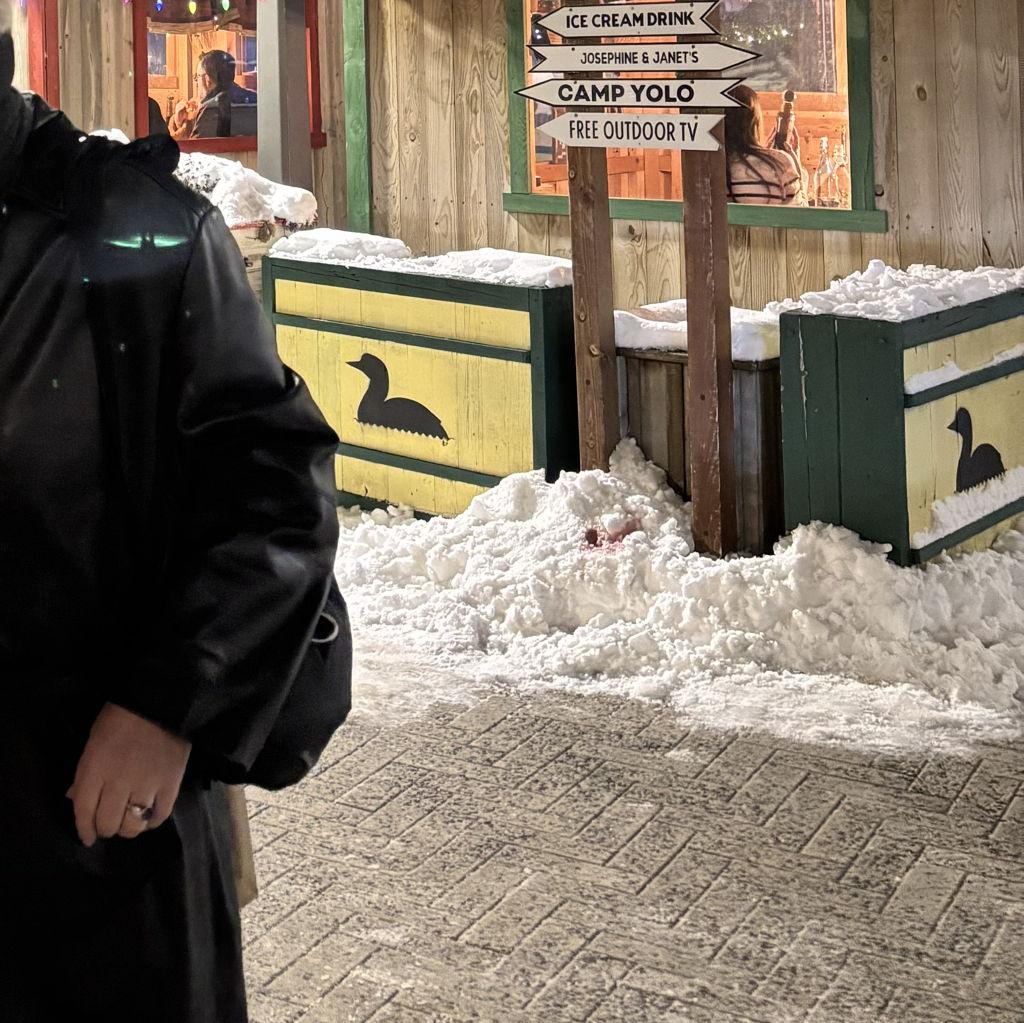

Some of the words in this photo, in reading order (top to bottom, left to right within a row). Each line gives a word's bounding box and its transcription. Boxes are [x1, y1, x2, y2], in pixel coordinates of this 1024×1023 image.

[566, 14, 588, 29] ICE
[592, 12, 644, 28] CREAM
[647, 11, 695, 26] DRINK
[580, 52, 638, 65] JOSEPHINE
[642, 52, 649, 63] &
[652, 51, 699, 64] JANET'S
[557, 84, 625, 102] CAMP
[631, 84, 695, 103] YOLO
[569, 120, 599, 139] FREE
[603, 121, 675, 141] OUTDOOR
[680, 121, 699, 142] TV
